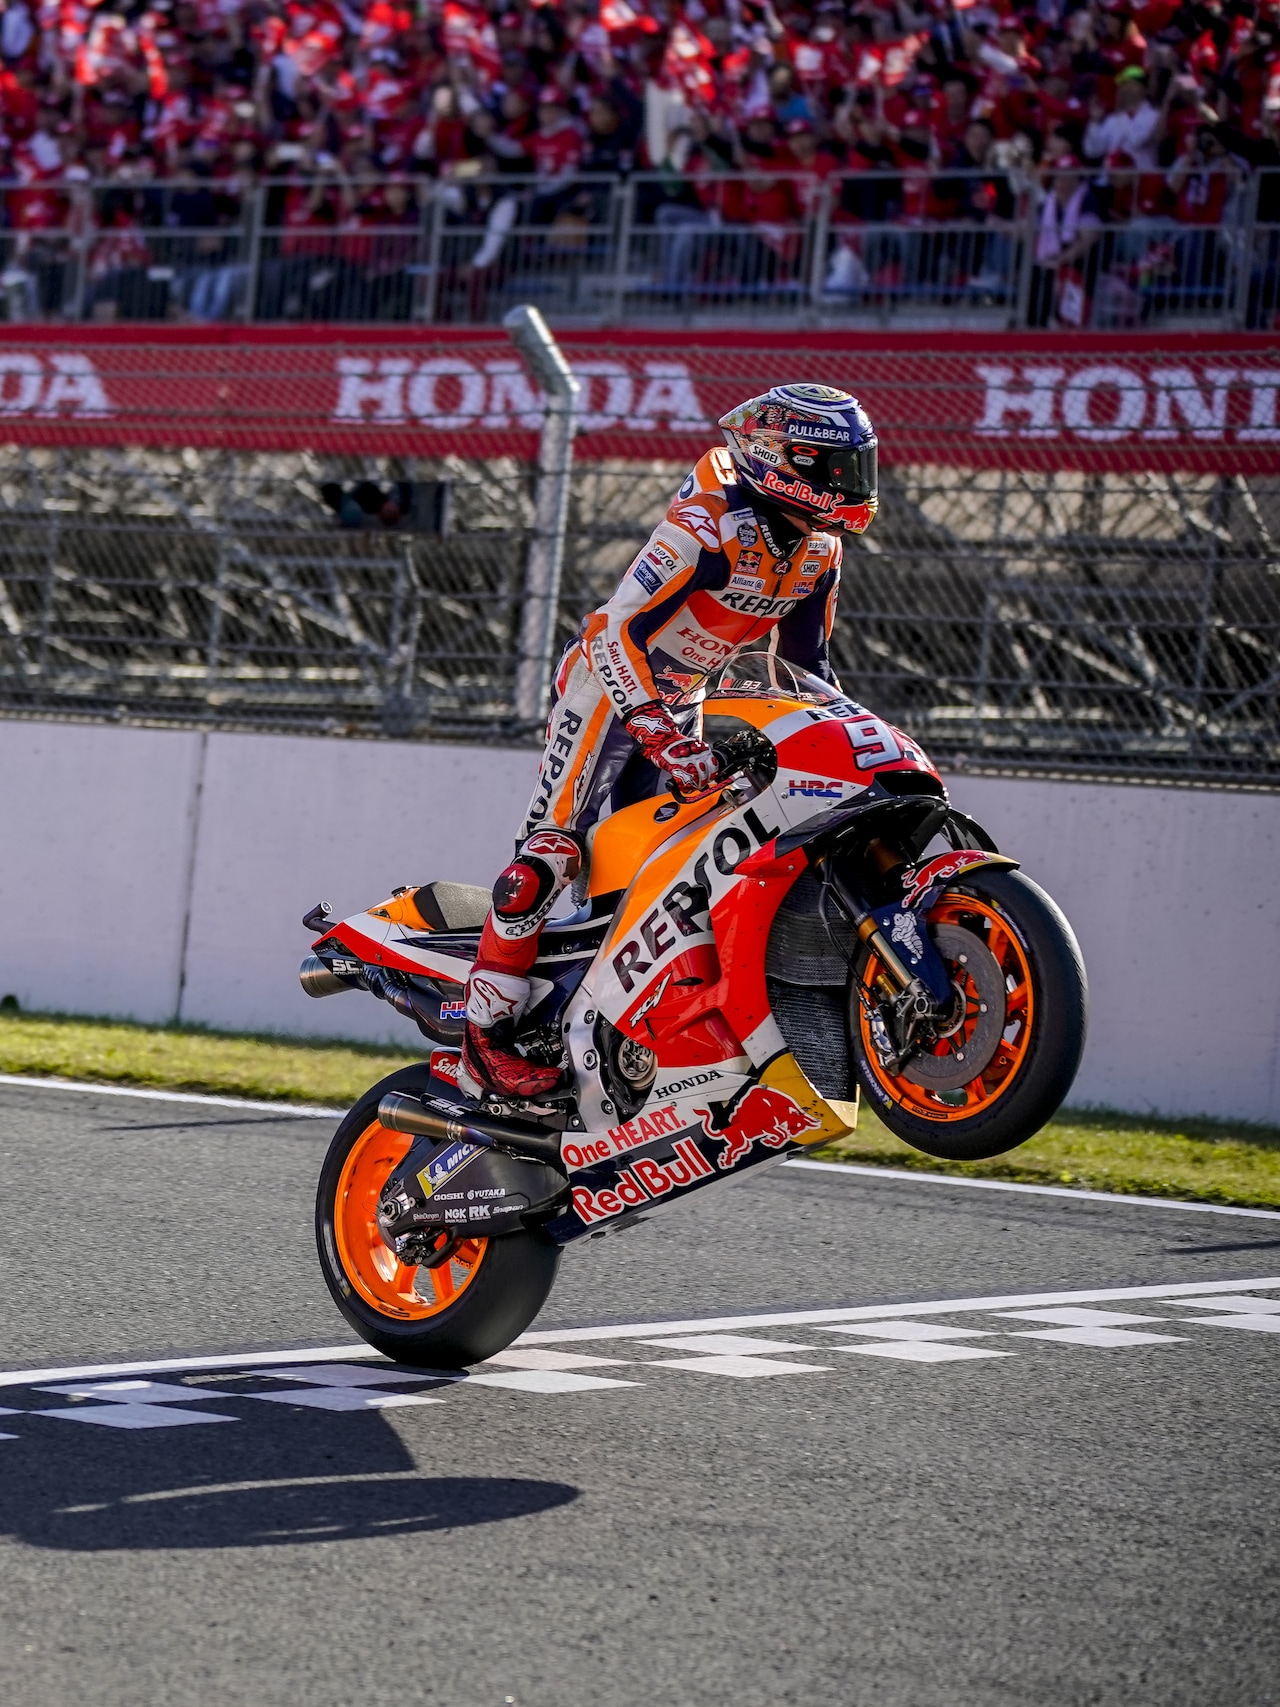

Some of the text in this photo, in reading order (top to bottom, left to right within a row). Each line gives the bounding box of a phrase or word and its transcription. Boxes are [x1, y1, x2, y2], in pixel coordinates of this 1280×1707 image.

[332, 358, 712, 431] HONDA
[788, 424, 850, 441] PULL&BEAR
[752, 445, 778, 463] SHOEI
[760, 524, 783, 558] REPSOL
[731, 576, 755, 587] Allianz
[607, 641, 622, 665] Satu
[681, 646, 707, 665] One
[591, 635, 636, 715] REPSOL
[741, 680, 762, 690] 93
[526, 708, 583, 833] REPSOL
[788, 779, 843, 798] HRC
[612, 806, 781, 994] REPSOL
[654, 1069, 724, 1099] HONDA
[562, 1104, 687, 1168] One HEART.
[433, 1192, 464, 1201] GOSHI
[474, 1188, 506, 1198] YUTAKA
[445, 1207, 467, 1219] NGK
[468, 1204, 491, 1218] RK
